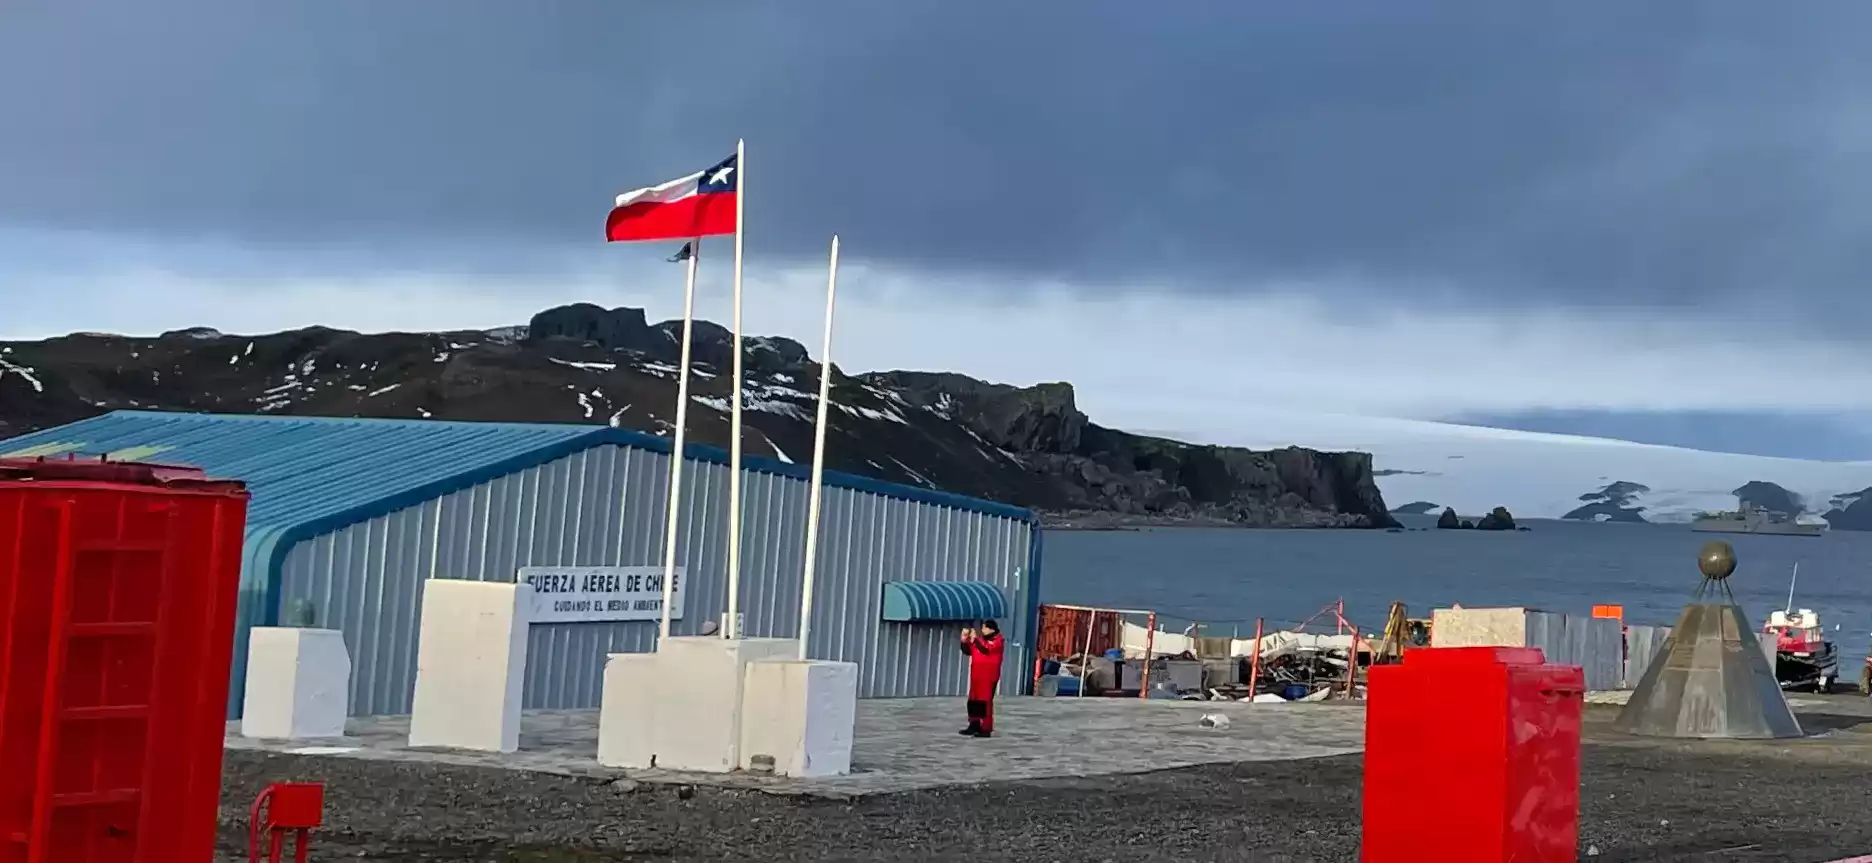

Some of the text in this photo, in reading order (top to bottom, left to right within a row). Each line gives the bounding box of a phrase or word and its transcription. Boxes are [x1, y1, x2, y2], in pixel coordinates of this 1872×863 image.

[527, 575, 575, 592] FUERZA
[626, 575, 641, 592] DE
[645, 575, 679, 592] CHIE
[554, 600, 591, 612] CUIDANDO
[594, 600, 603, 612] EL
